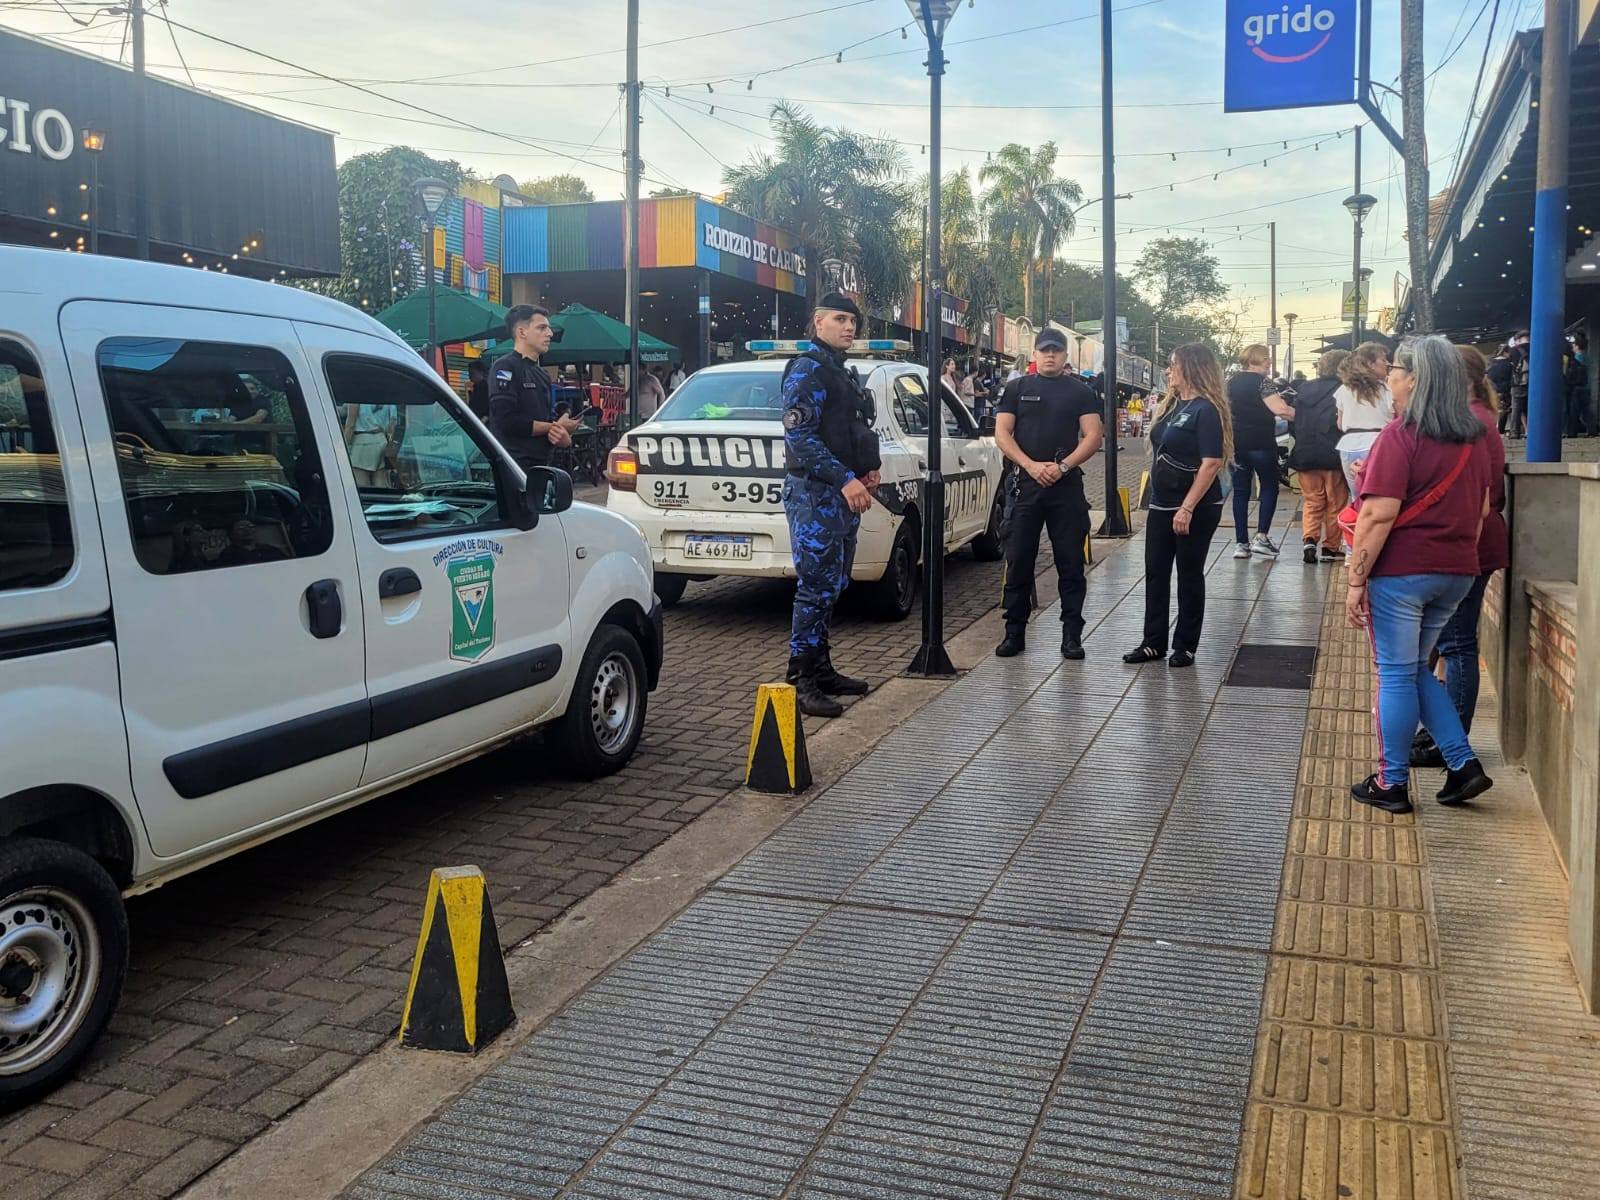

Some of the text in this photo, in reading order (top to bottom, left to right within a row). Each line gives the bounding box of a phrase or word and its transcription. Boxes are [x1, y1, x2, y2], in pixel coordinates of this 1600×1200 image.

[1243, 3, 1335, 45] grido
[0, 95, 74, 160] IO
[705, 222, 750, 260] RODIZIO
[752, 239, 768, 264] DE
[653, 480, 689, 499] 911
[721, 480, 783, 504] 3-95
[467, 539, 477, 550] DE
[477, 539, 503, 555] CULTURA
[687, 542, 749, 558] AE 469 HJ
